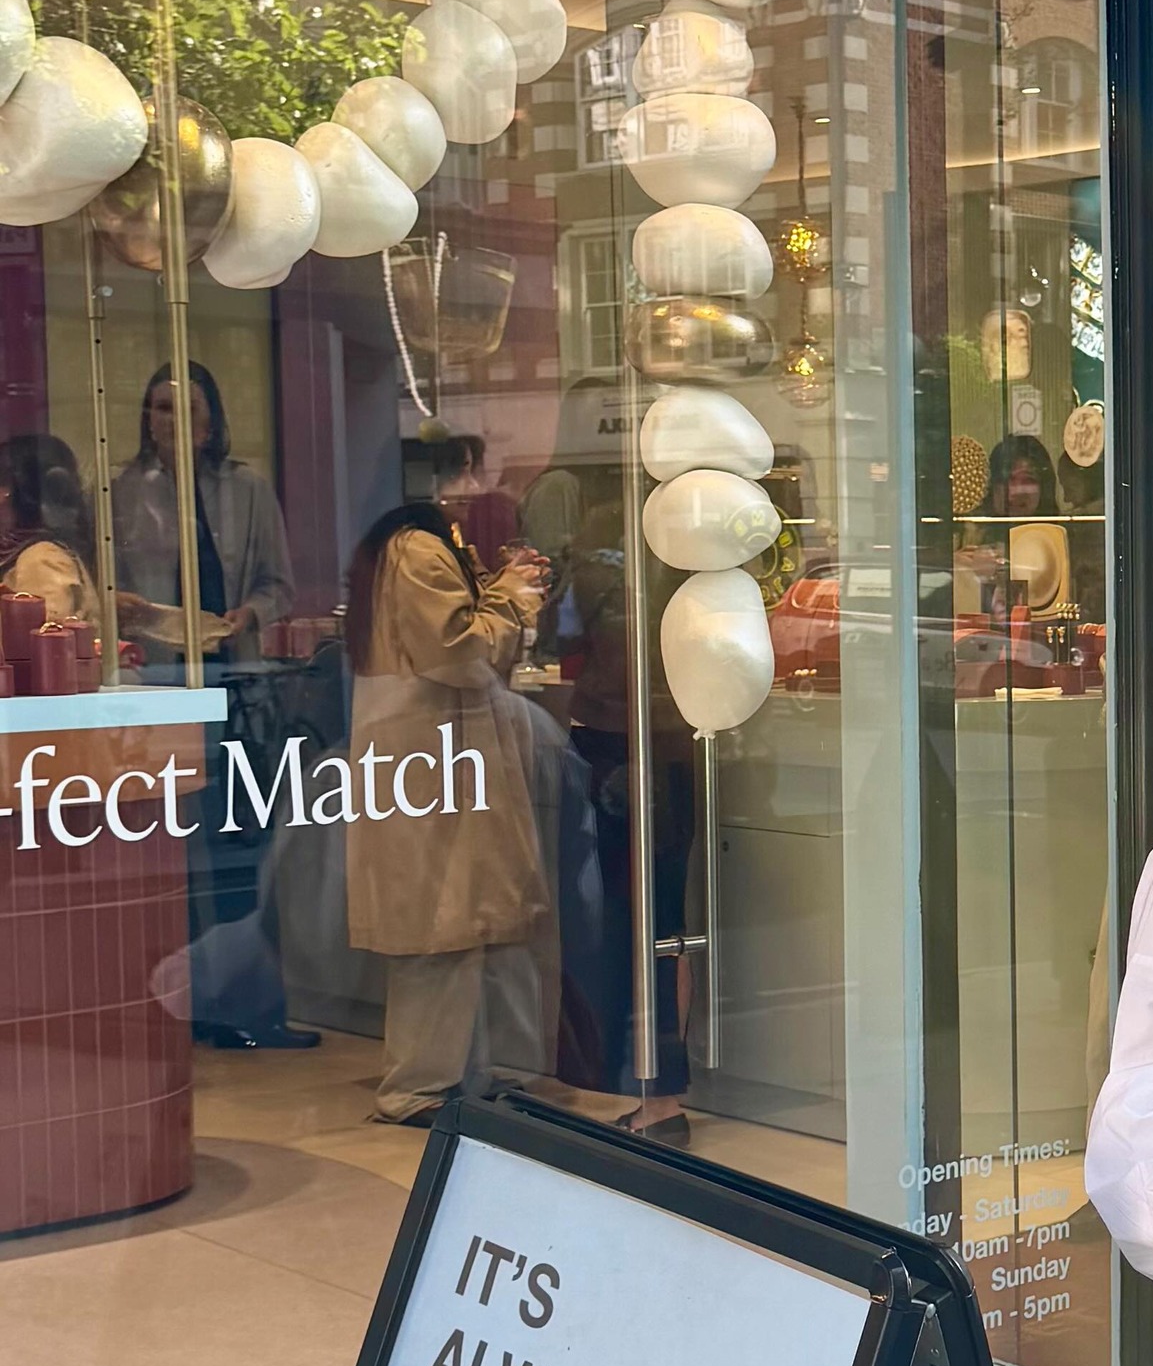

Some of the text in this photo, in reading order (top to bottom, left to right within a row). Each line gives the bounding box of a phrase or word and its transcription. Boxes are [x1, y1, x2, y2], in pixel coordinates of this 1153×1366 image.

[218, 722, 490, 833] Match
[898, 1138, 1070, 1191] Opening Times:
[975, 1187, 1071, 1223] Saturday
[455, 1235, 560, 1329] IT’S
[991, 1256, 1071, 1291] Sunday
[1023, 1292, 1070, 1321] 5pm
